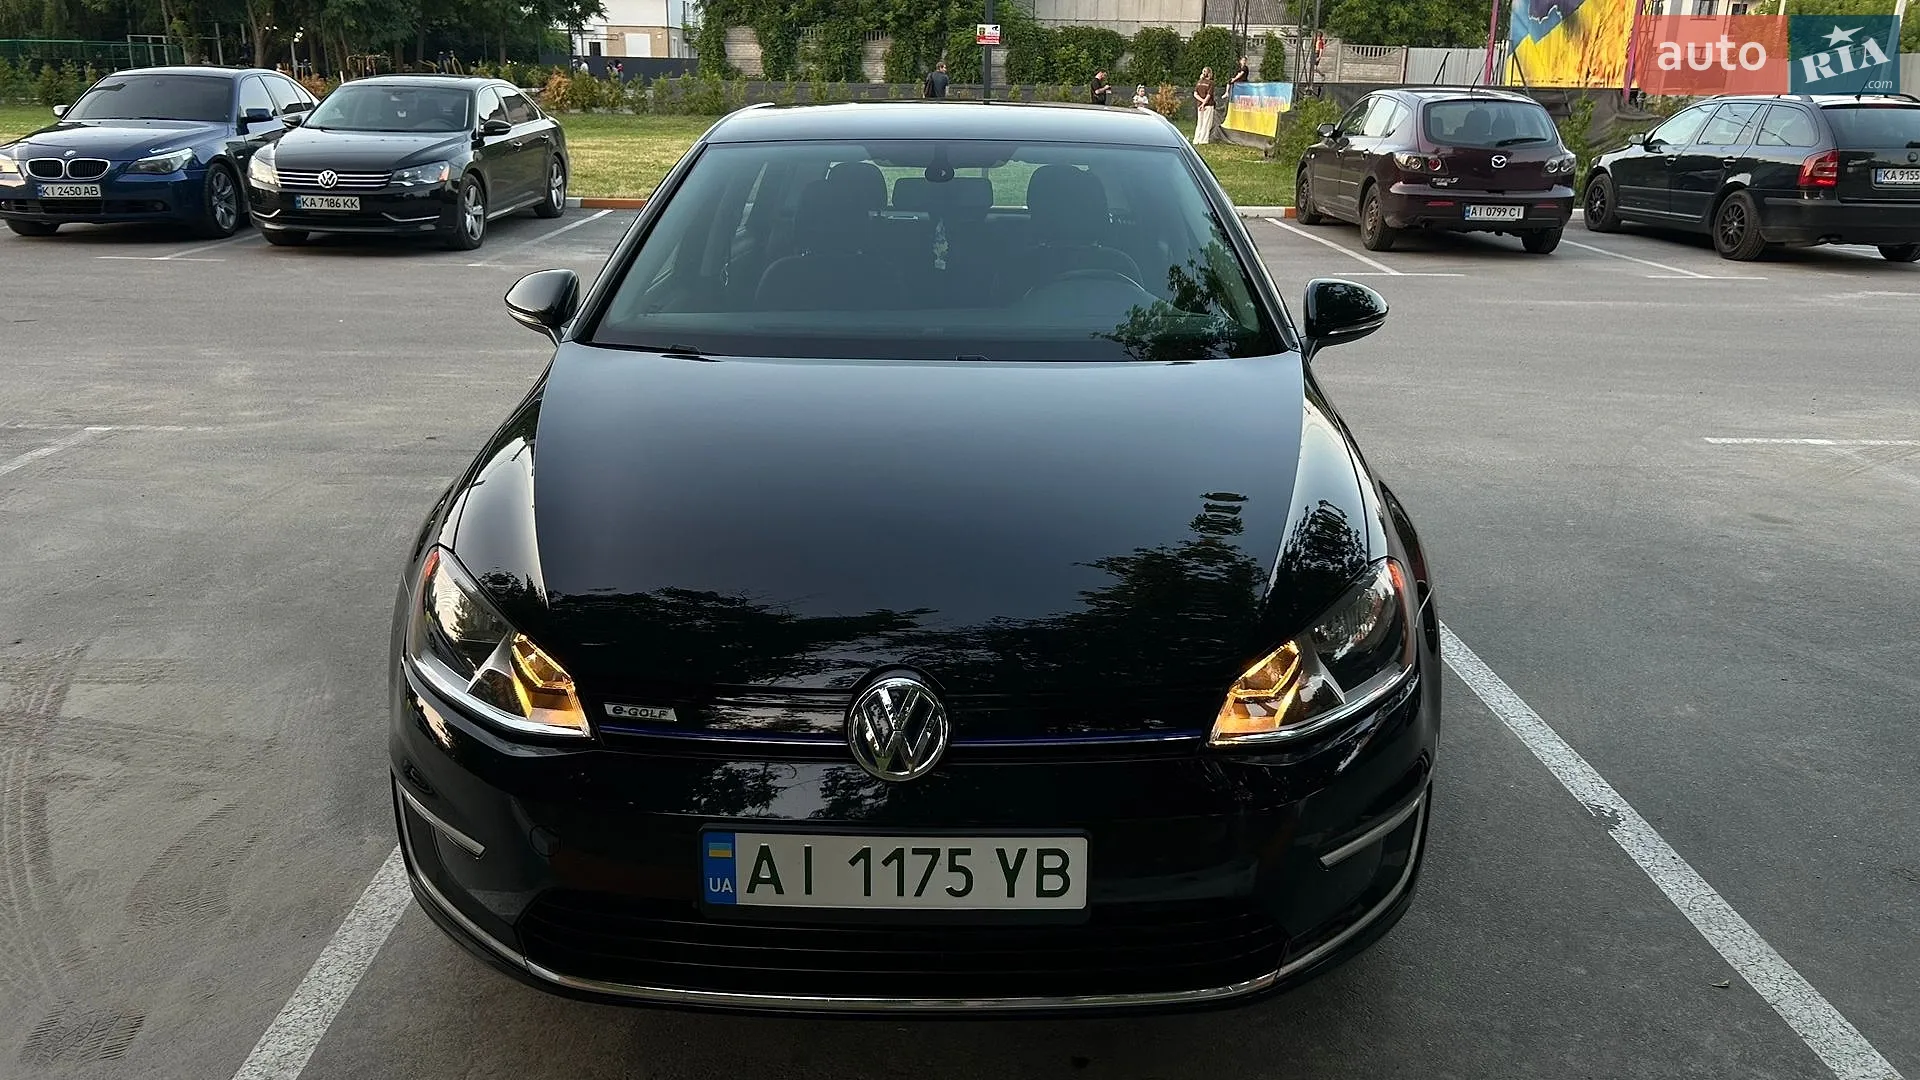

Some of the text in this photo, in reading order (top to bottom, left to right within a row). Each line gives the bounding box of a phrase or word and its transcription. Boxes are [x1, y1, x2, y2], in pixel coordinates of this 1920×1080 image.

[1883, 170, 1897, 180] KA
[57, 186, 81, 196] 2450
[83, 186, 99, 196] AB
[302, 197, 358, 209] KA 7186 KK
[1470, 207, 1520, 217] AI 0799 CI
[612, 705, 668, 718] e-GOLF
[745, 843, 1071, 899] AI 1175 YB
[709, 877, 733, 893] UA
